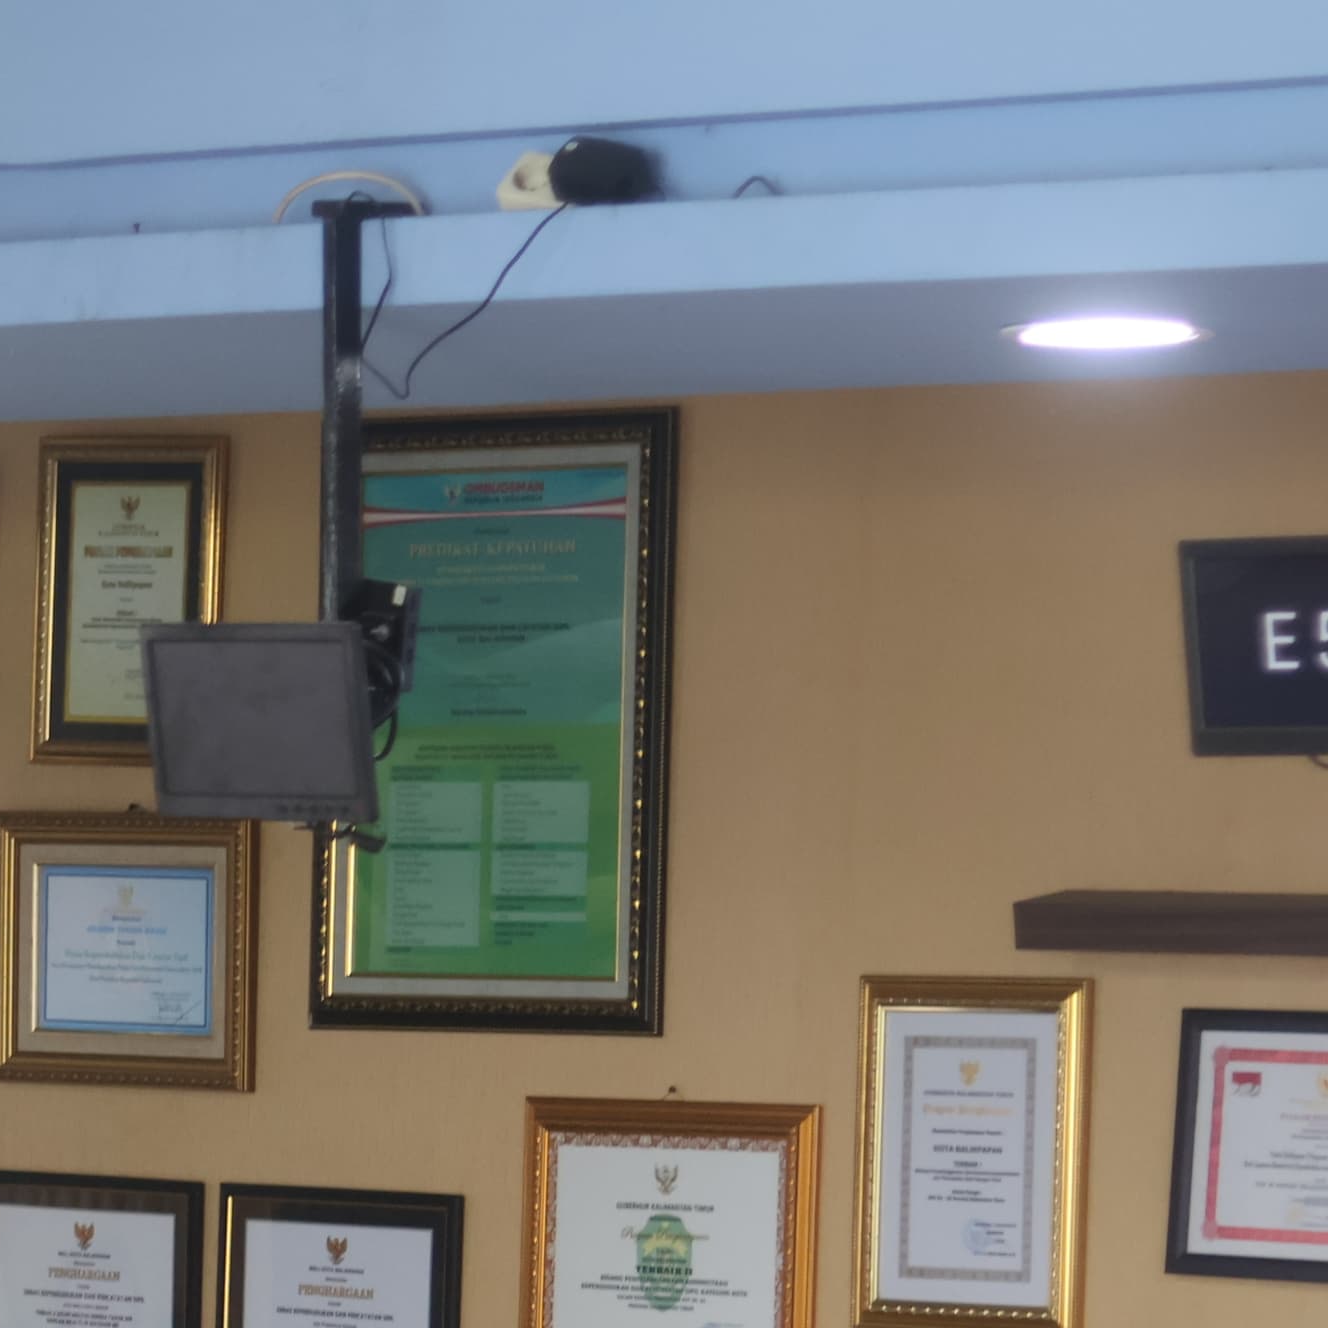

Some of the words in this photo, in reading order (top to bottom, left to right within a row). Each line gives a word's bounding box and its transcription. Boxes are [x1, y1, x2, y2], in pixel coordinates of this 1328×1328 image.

[1263, 610, 1300, 671] E
[47, 1266, 121, 1281] PENGHARGAAN
[298, 1283, 375, 1300] PENGHARGAAN
